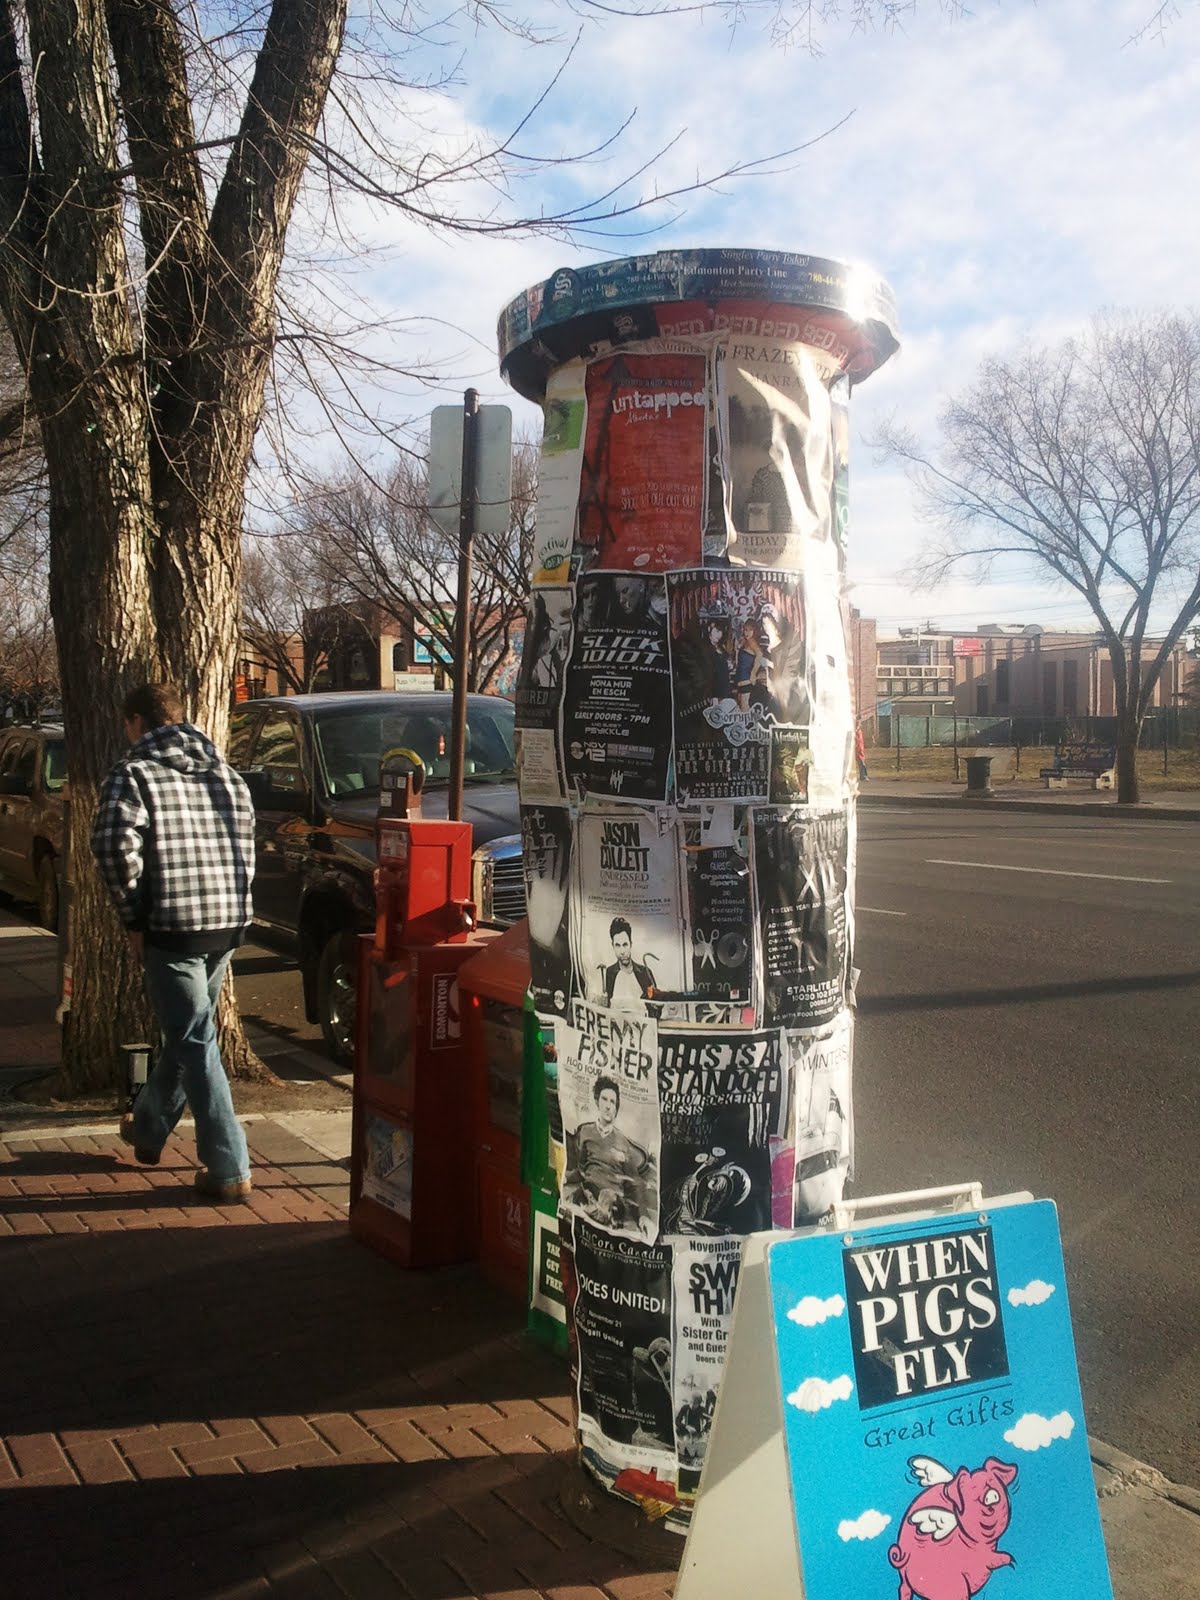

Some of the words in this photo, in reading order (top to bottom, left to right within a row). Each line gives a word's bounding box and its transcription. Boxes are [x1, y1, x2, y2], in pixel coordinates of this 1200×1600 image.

[720, 249, 753, 262] Singles
[782, 254, 810, 266] Today!
[683, 265, 735, 276] Edmonton
[738, 265, 764, 277] Party
[767, 267, 788, 278] Line
[581, 635, 664, 652] SLICK
[582, 650, 664, 665] IDIOT
[592, 688, 602, 696] EN
[603, 688, 627, 696] ESCH
[574, 711, 595, 719] EARLY
[594, 712, 622, 721] DOORS
[630, 715, 650, 724] 7PM
[585, 748, 606, 762] 12
[601, 821, 640, 847] JASON
[600, 845, 650, 871] COLLETT
[786, 980, 831, 996] STARLITE
[436, 979, 448, 1040] EDMONTON
[575, 1003, 648, 1050] EREMY
[577, 1033, 653, 1081] FISHER
[546, 1241, 561, 1258] TAK
[689, 1239, 742, 1253] November
[716, 1252, 742, 1261] Prese
[850, 1232, 990, 1293] WHEN
[546, 1258, 560, 1274] GET
[579, 1273, 609, 1300] OICES
[612, 1287, 666, 1314] UNITED!
[700, 1317, 721, 1328] With
[857, 1276, 997, 1354] PIGS
[602, 1332, 624, 1348] United
[682, 1326, 714, 1341] Sister
[688, 1342, 704, 1352] and
[695, 1354, 716, 1364] Doors
[891, 1337, 973, 1397] FLY
[864, 1416, 936, 1449] Great
[947, 1395, 1015, 1429] Gifts
